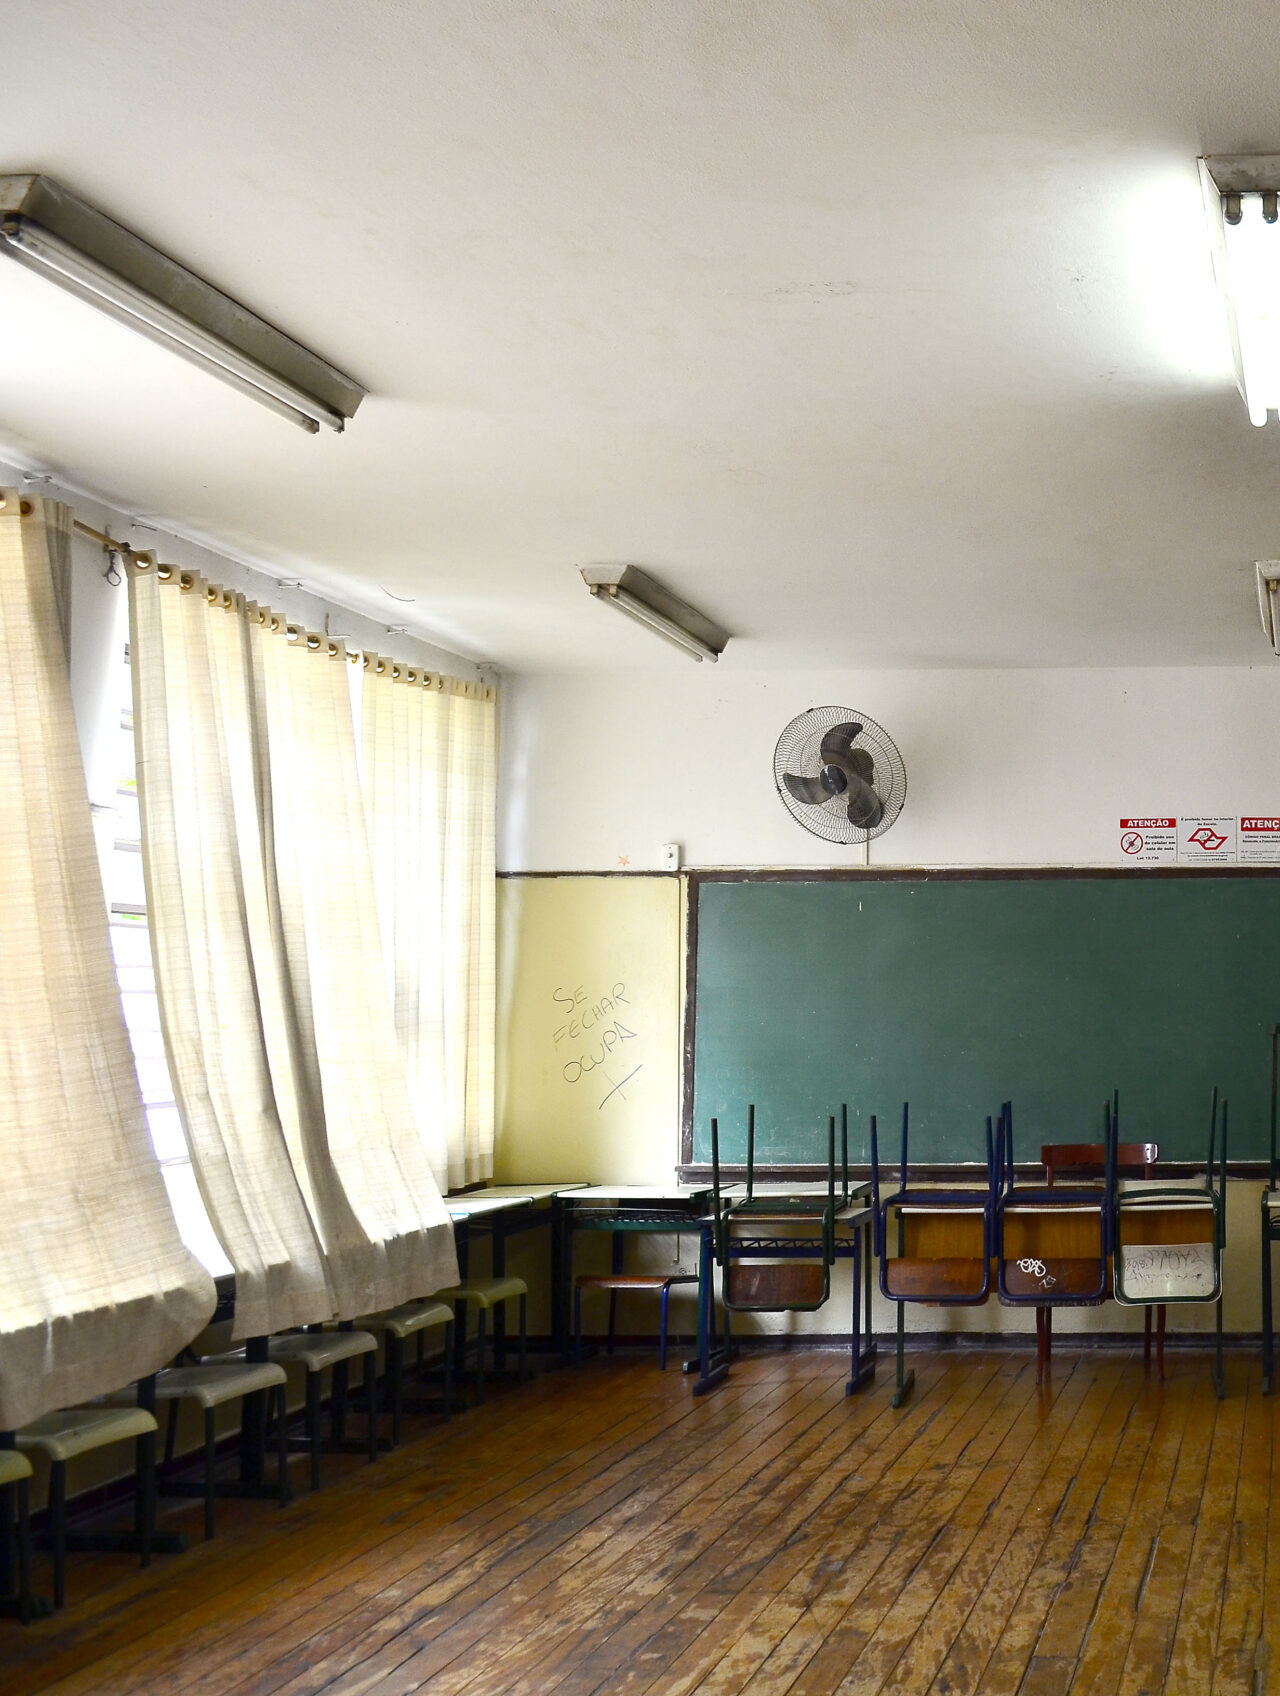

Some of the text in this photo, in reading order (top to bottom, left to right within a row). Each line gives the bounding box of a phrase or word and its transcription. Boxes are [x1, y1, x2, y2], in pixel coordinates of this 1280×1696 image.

[1127, 818, 1170, 828] ATENÇÃO
[552, 983, 588, 1014] SE
[552, 982, 631, 1053] FECHAR
[562, 1020, 638, 1083] OCUPA
